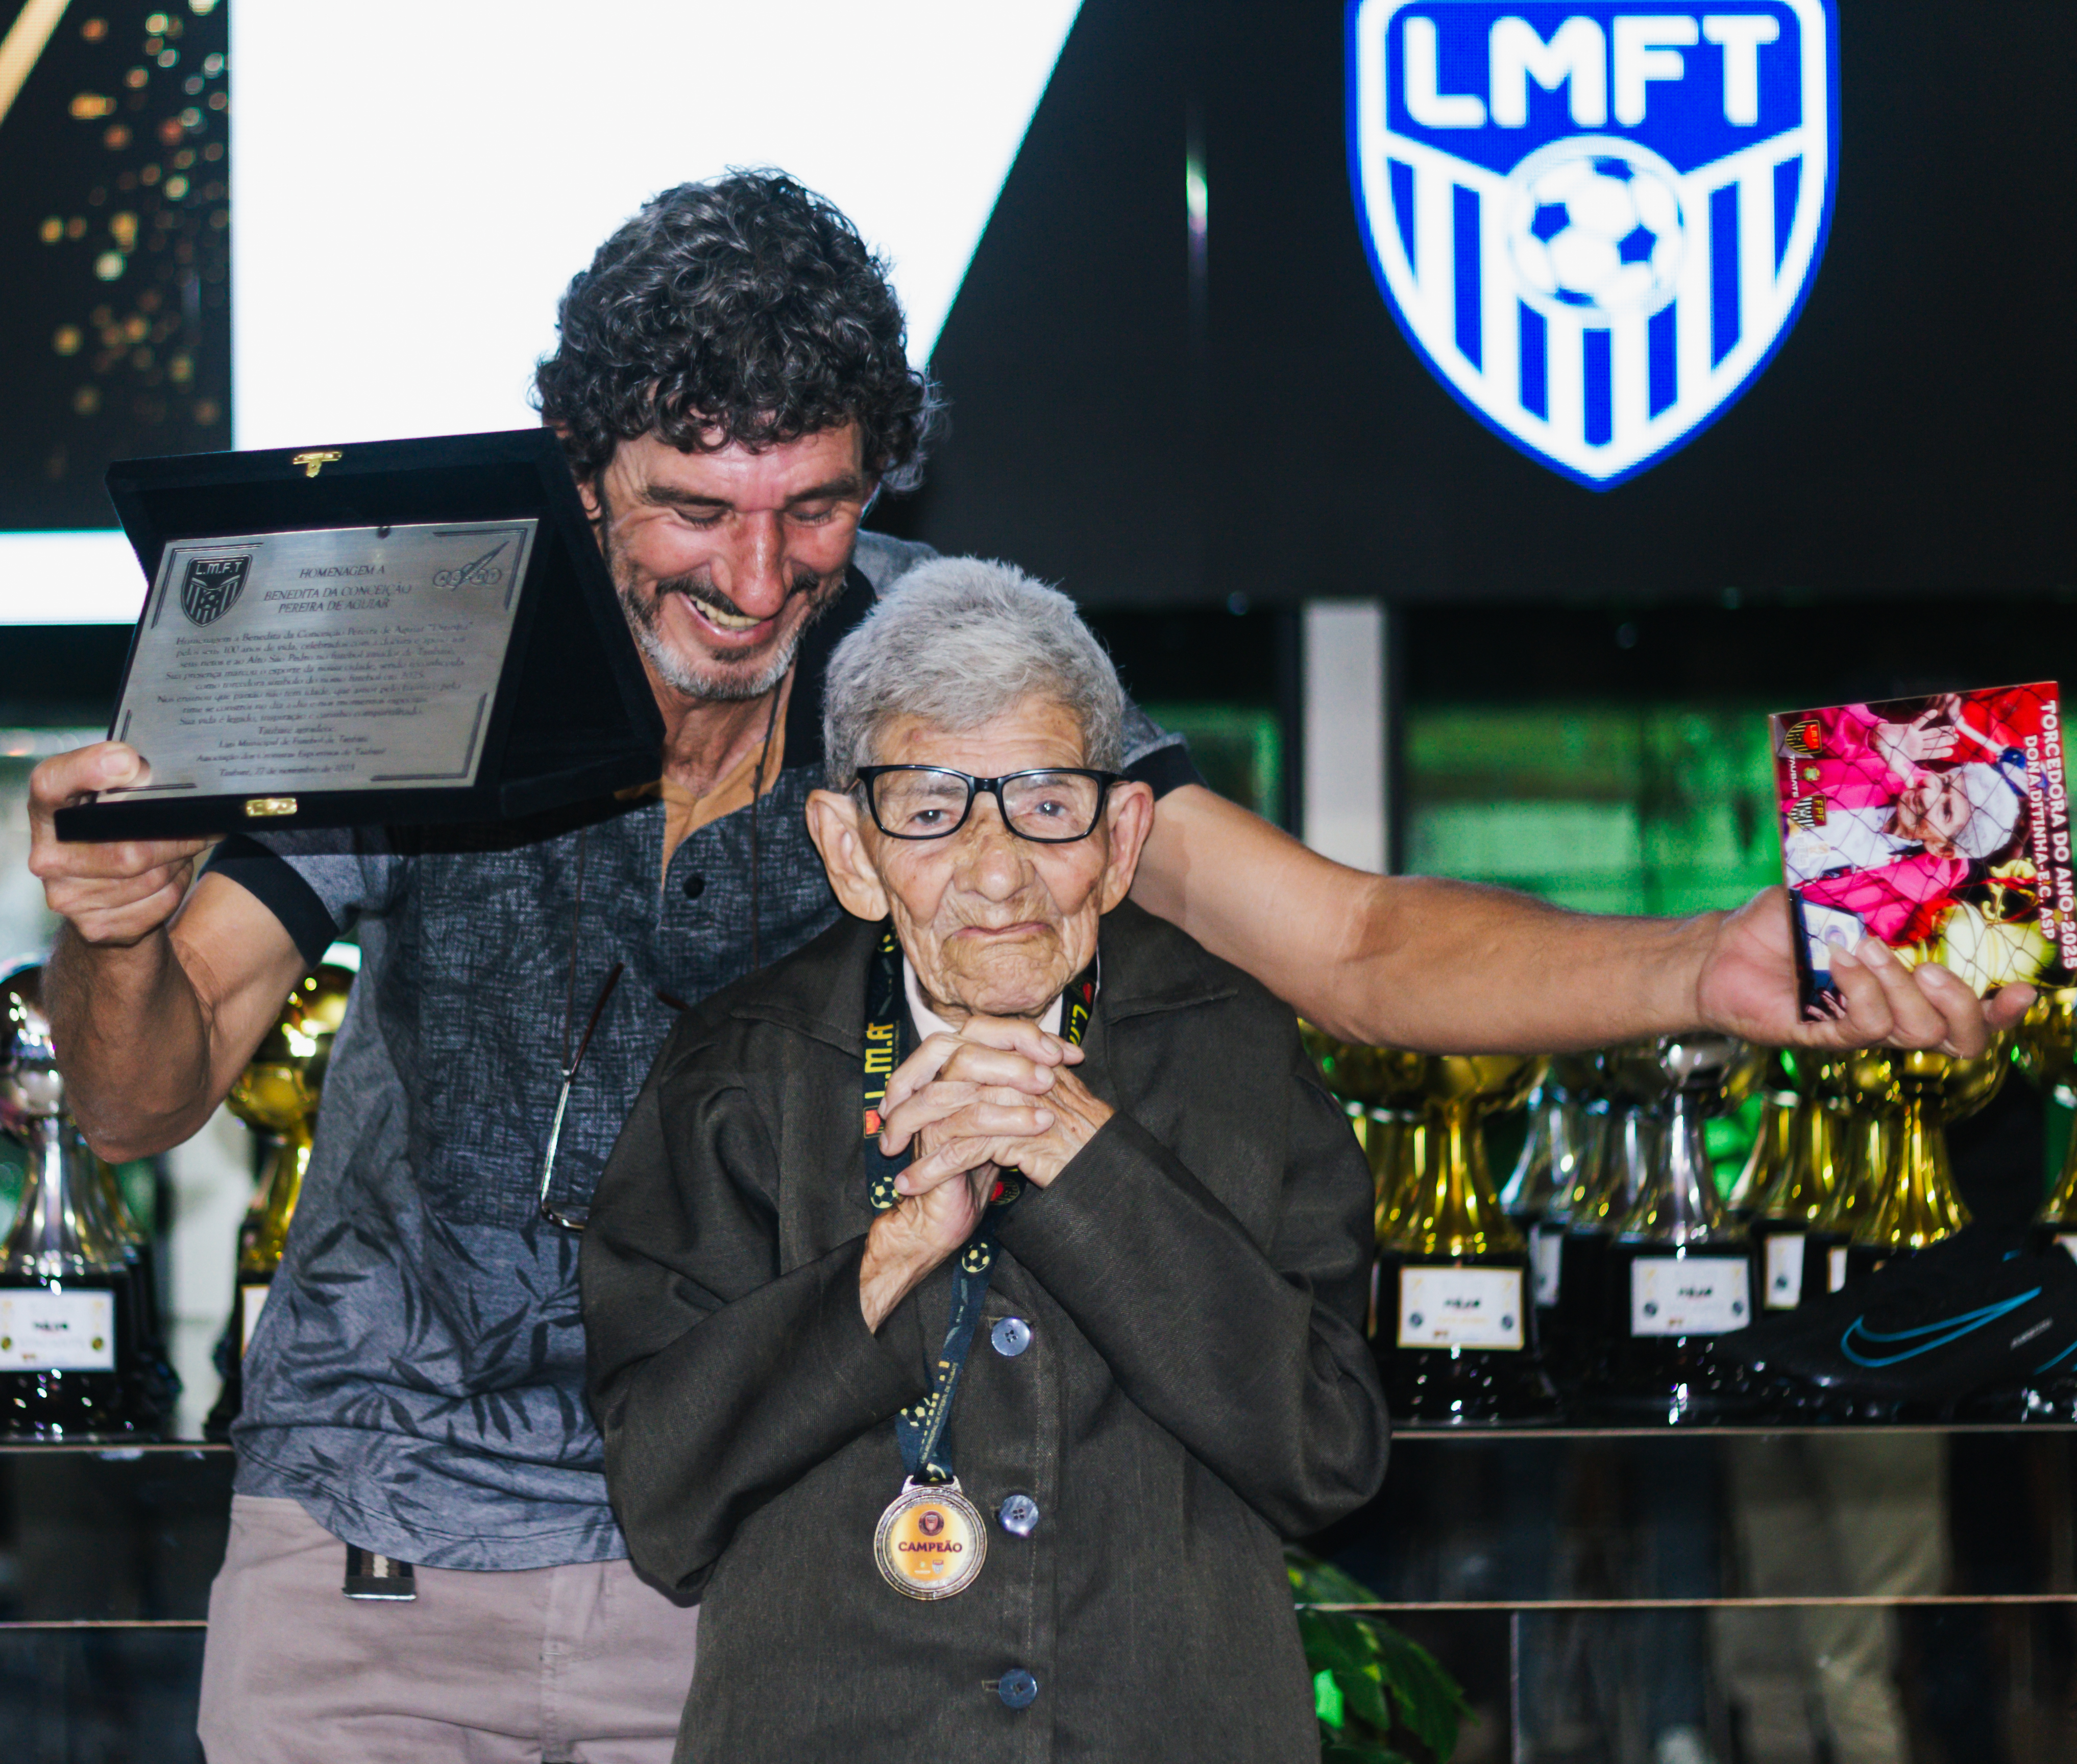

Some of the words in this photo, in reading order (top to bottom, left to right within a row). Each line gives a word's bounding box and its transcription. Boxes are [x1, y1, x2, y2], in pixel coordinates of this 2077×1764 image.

[1403, 15, 1780, 129] LMFT
[299, 566, 375, 578] HOMENAGEM
[378, 565, 384, 574] A
[264, 589, 320, 601] BENEDITA
[323, 587, 337, 597] DA
[341, 582, 412, 596] CONCEIÇÃO
[278, 602, 323, 613] PEREIRA
[327, 601, 341, 610] DE
[345, 598, 390, 609] AGUIAR
[176, 637, 231, 645] Homenagem
[242, 632, 280, 641] Benedita
[283, 631, 294, 639] da
[297, 630, 343, 638] Conceição
[381, 625, 389, 633] de
[264, 643, 274, 651] de
[2040, 700, 2067, 827] TORCEDORA
[1814, 800, 1824, 822] FPF
[2023, 735, 2041, 786] DONA
[2039, 907, 2056, 939] ASP
[2052, 831, 2070, 862] DO
[2055, 867, 2077, 969] ANO-2025
[898, 1540, 963, 1553] CAMPEÃO
